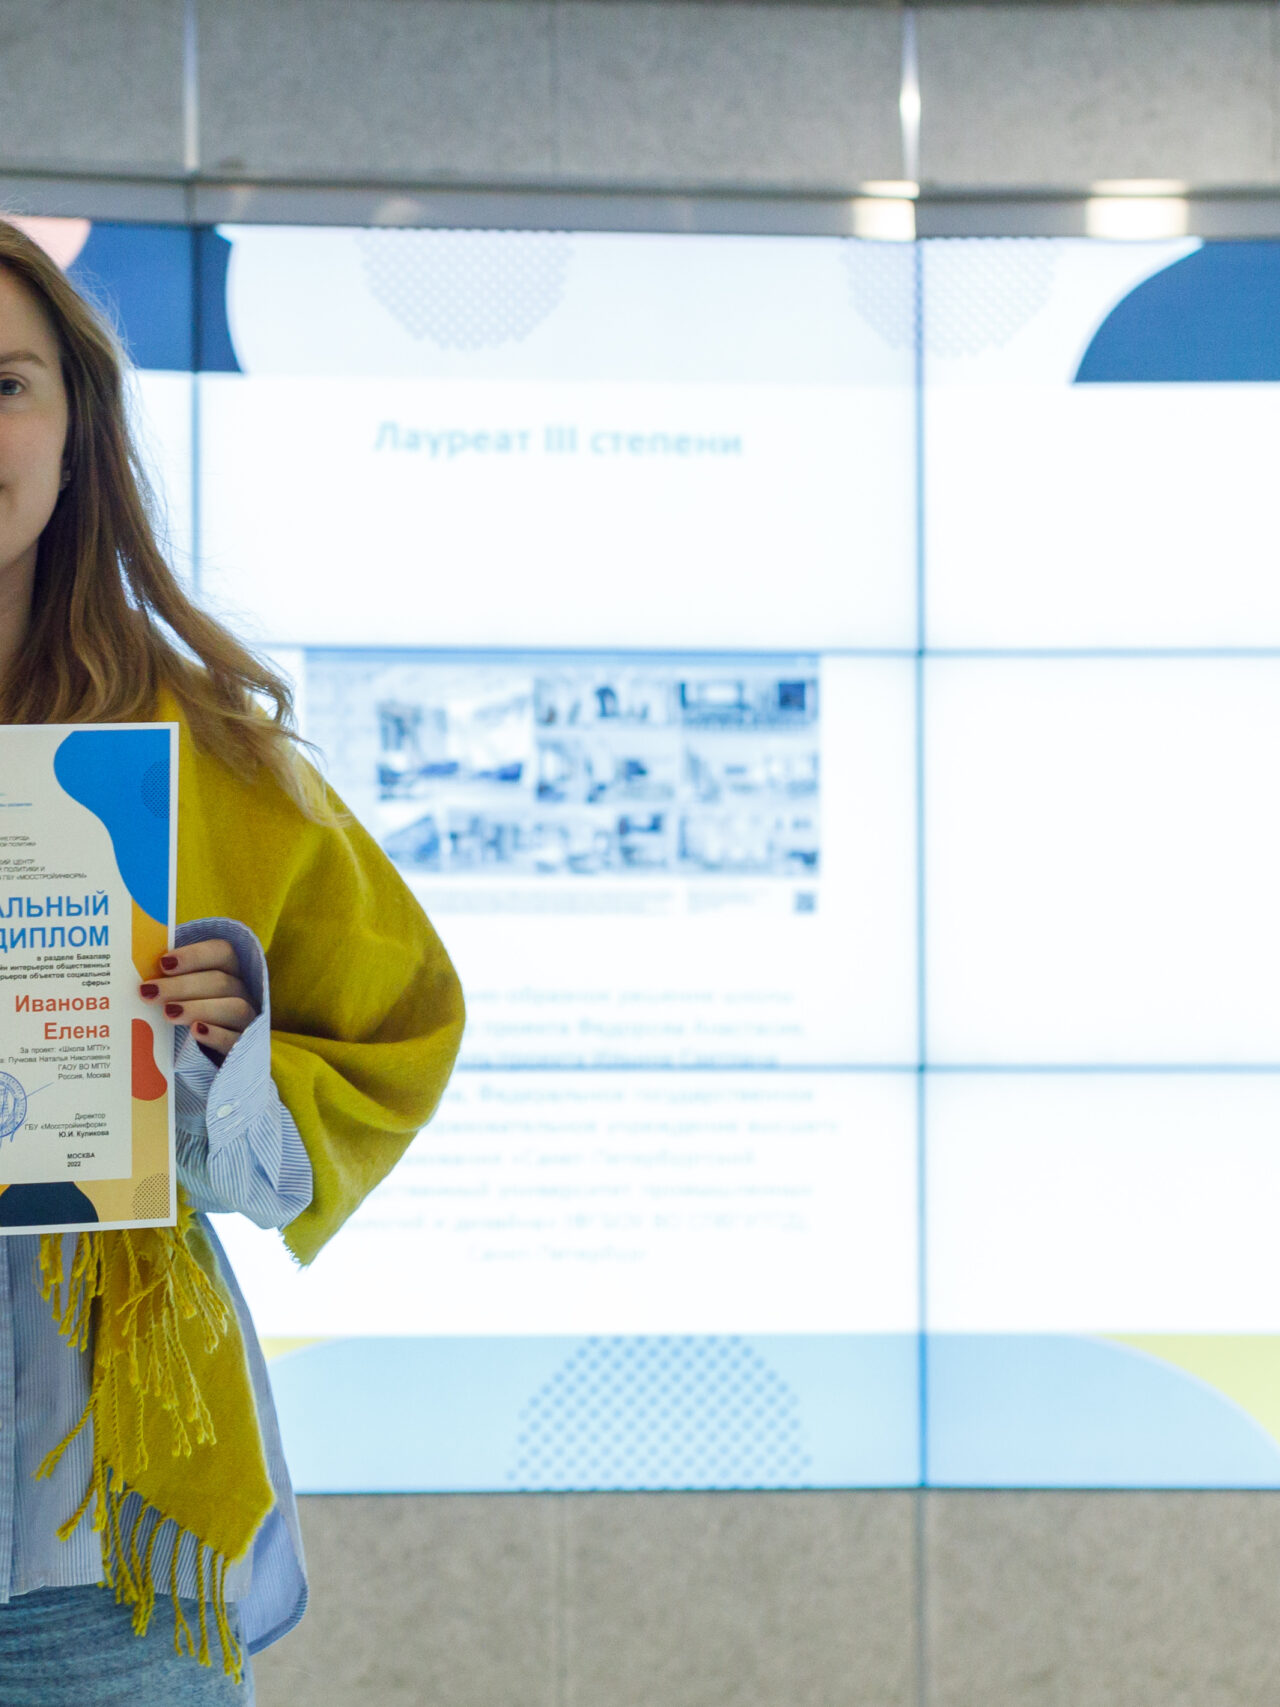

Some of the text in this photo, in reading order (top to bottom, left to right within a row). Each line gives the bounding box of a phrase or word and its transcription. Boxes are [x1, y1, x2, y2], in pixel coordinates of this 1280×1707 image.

[375, 420, 531, 458] Лауреат
[588, 430, 742, 455] степени
[44, 954, 74, 963] разделе
[76, 953, 111, 962] Бакалавр
[10, 963, 54, 972] интерьеров
[56, 962, 110, 970] общественных
[29, 971, 65, 980] объектов
[67, 970, 111, 979] социальной
[81, 979, 111, 988] сферы»
[15, 995, 110, 1013] Иванова
[44, 1022, 110, 1040] Елена
[77, 1130, 109, 1138] Куликова
